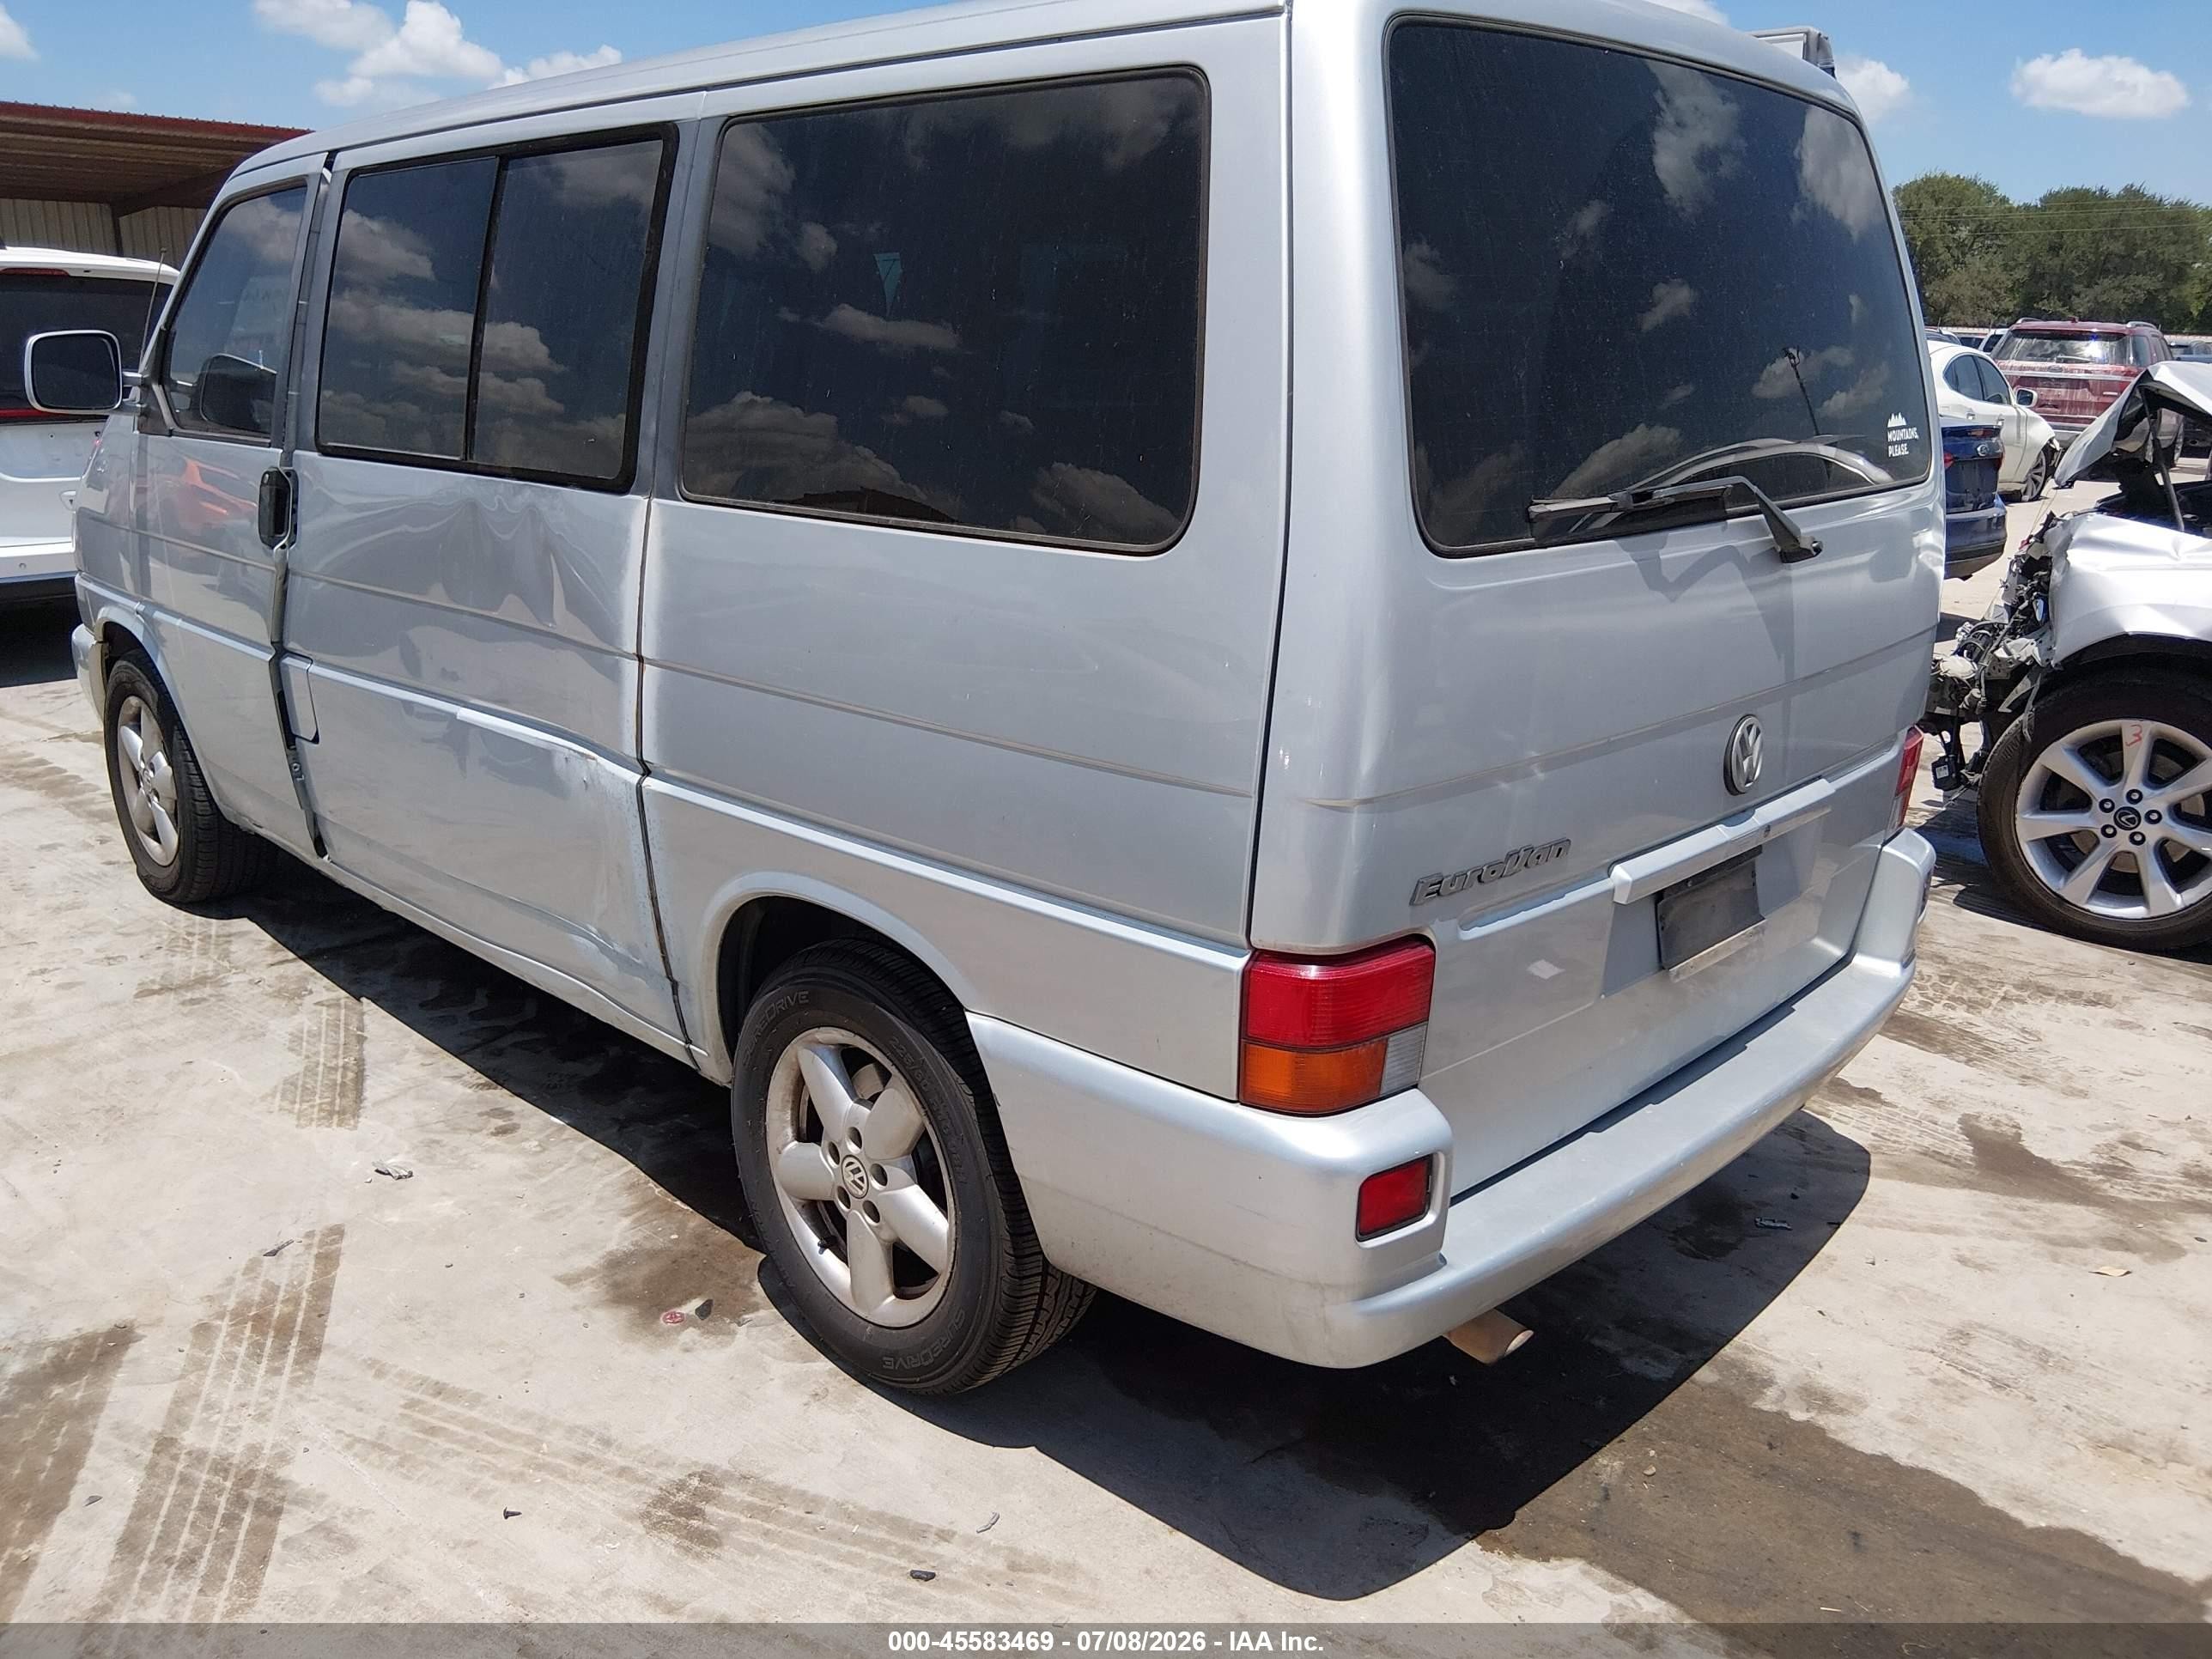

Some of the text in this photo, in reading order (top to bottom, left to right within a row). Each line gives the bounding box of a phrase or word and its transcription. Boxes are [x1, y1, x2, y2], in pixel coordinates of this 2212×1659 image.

[1887, 427, 1919, 442] MOUNTAINS,
[1888, 443, 1909, 458] PLEASE.
[2125, 724, 2142, 747] 3
[1409, 837, 1571, 906] EuroVan
